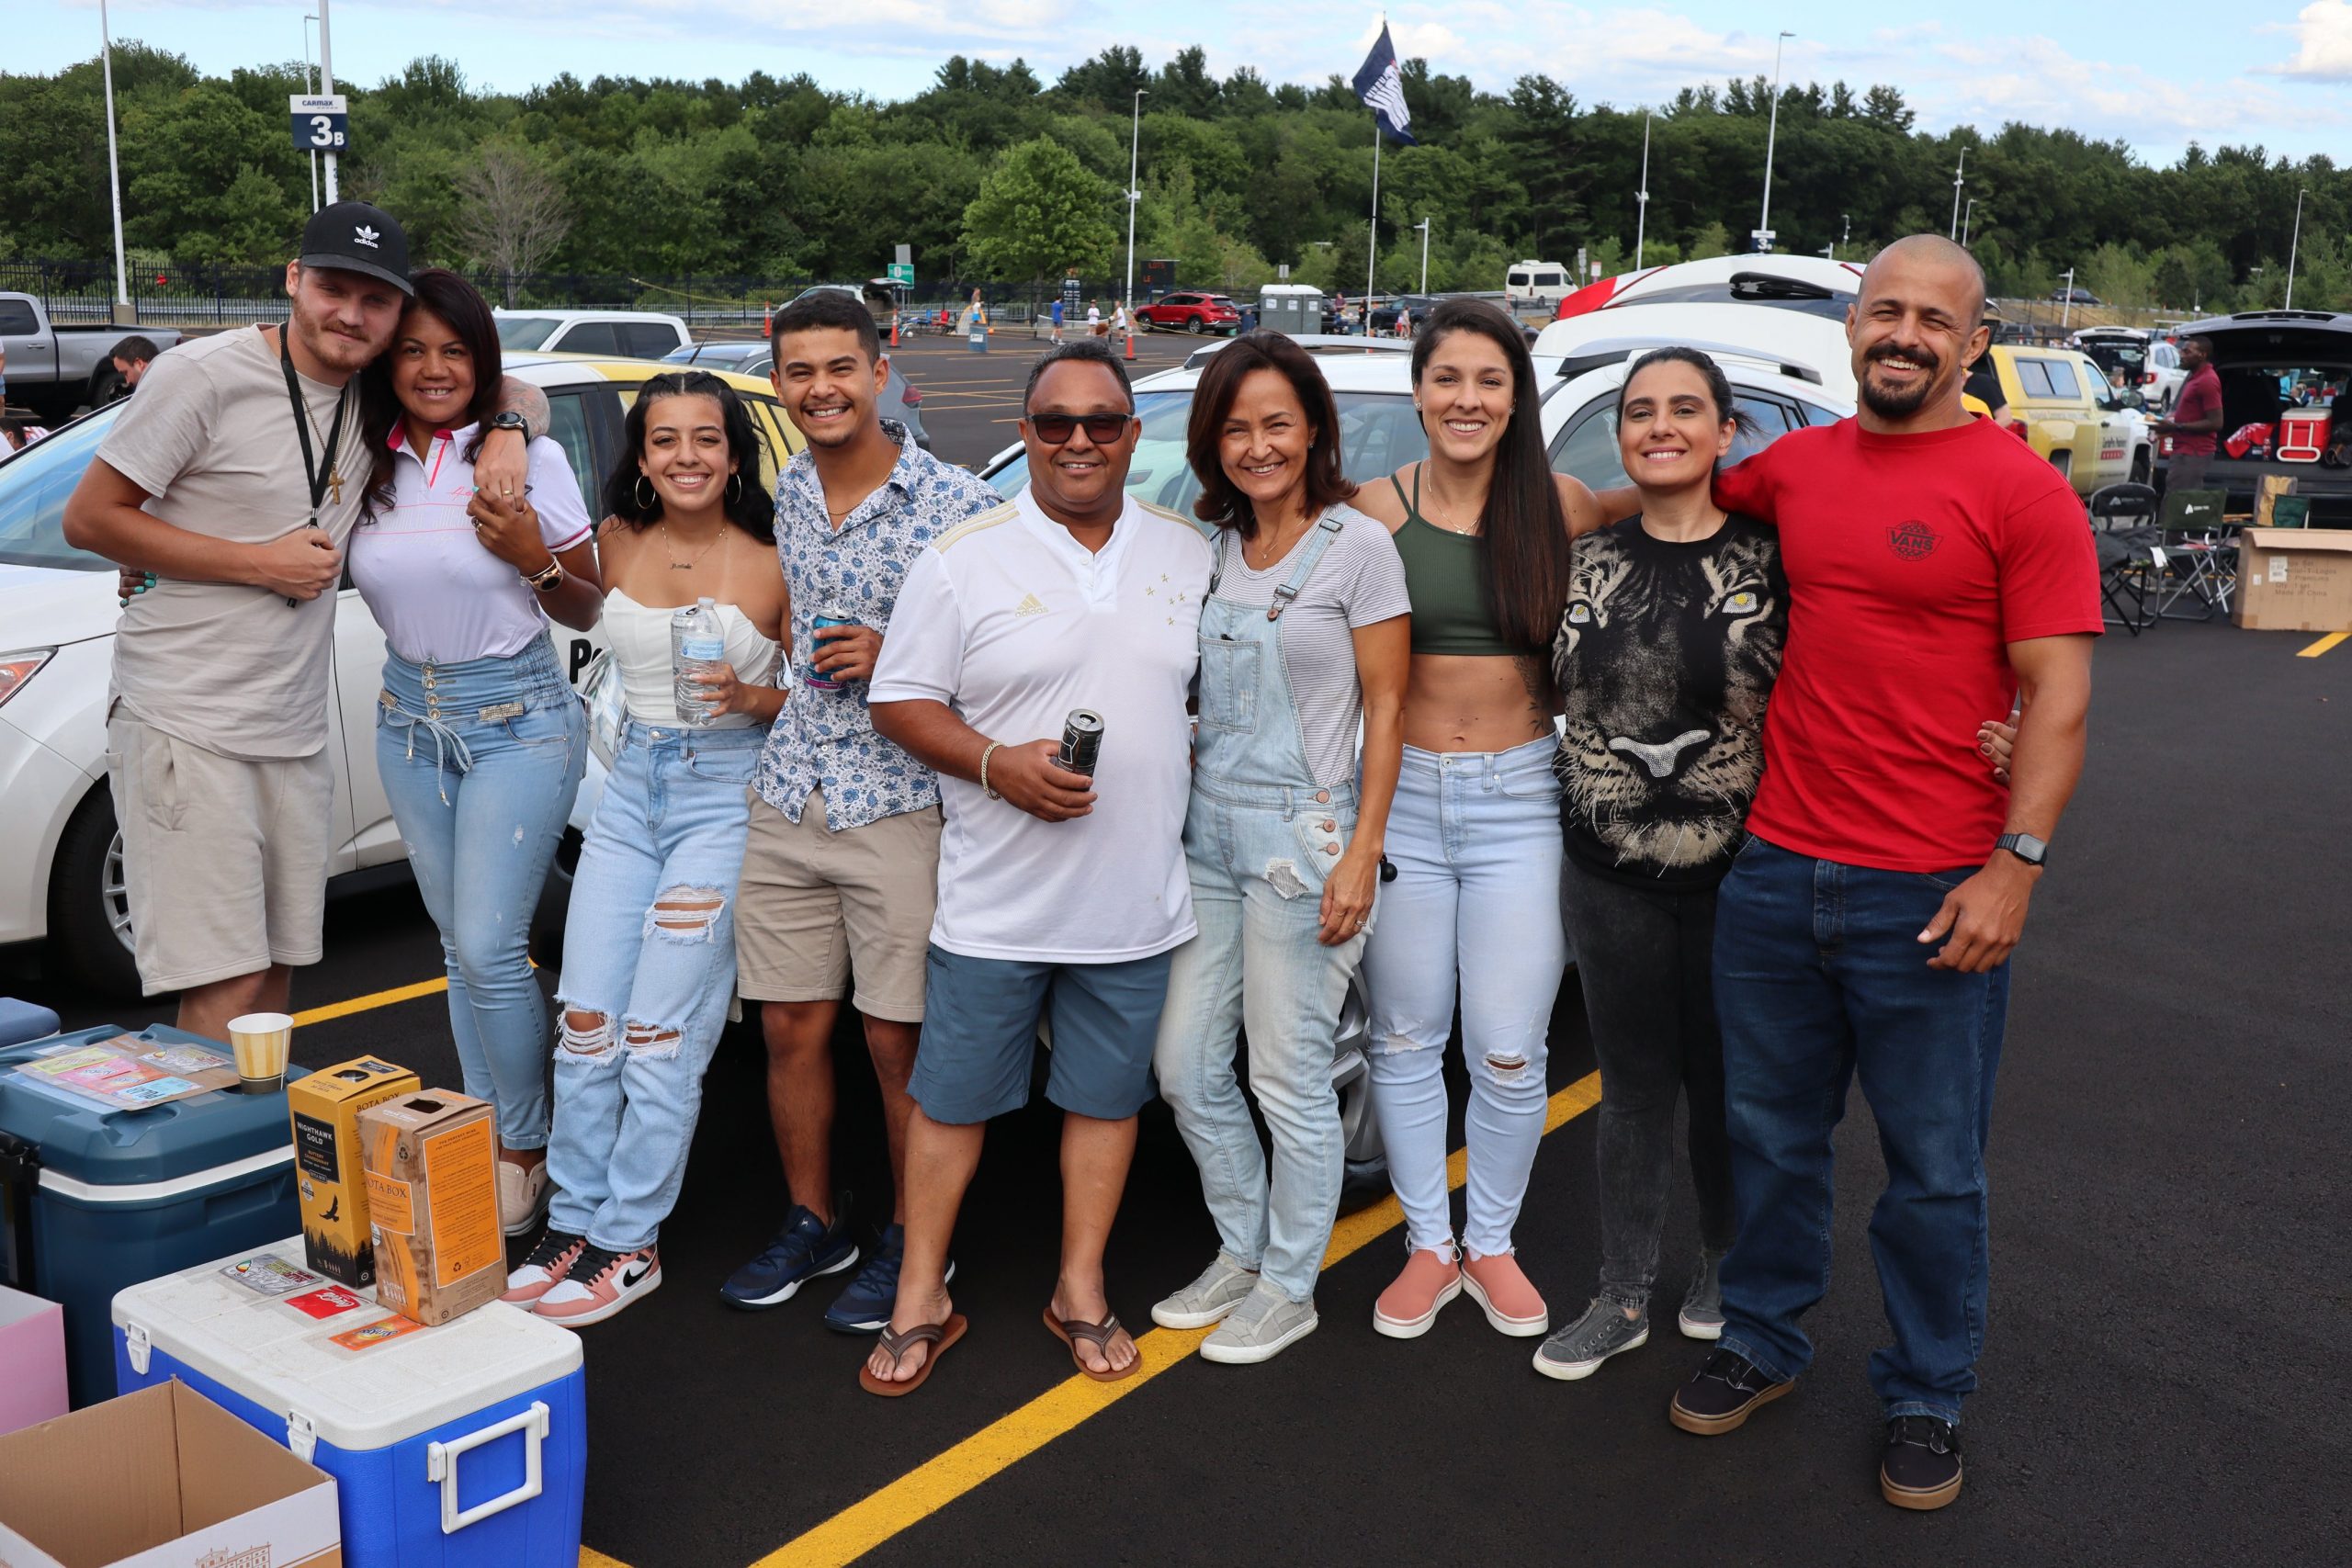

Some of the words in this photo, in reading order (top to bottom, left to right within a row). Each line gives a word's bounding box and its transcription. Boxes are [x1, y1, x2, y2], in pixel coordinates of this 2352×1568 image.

[311, 115, 345, 146] 3B
[354, 238, 379, 249] adidas
[1891, 530, 1935, 551] VANS
[1015, 606, 1049, 617] adidas
[356, 1099, 380, 1112] BOTA
[382, 1091, 400, 1102] BOX
[297, 1121, 334, 1141] NIGHTHAWK
[306, 1133, 323, 1145] GOLD
[368, 1179, 384, 1192] OTA
[387, 1184, 407, 1198] BOX
